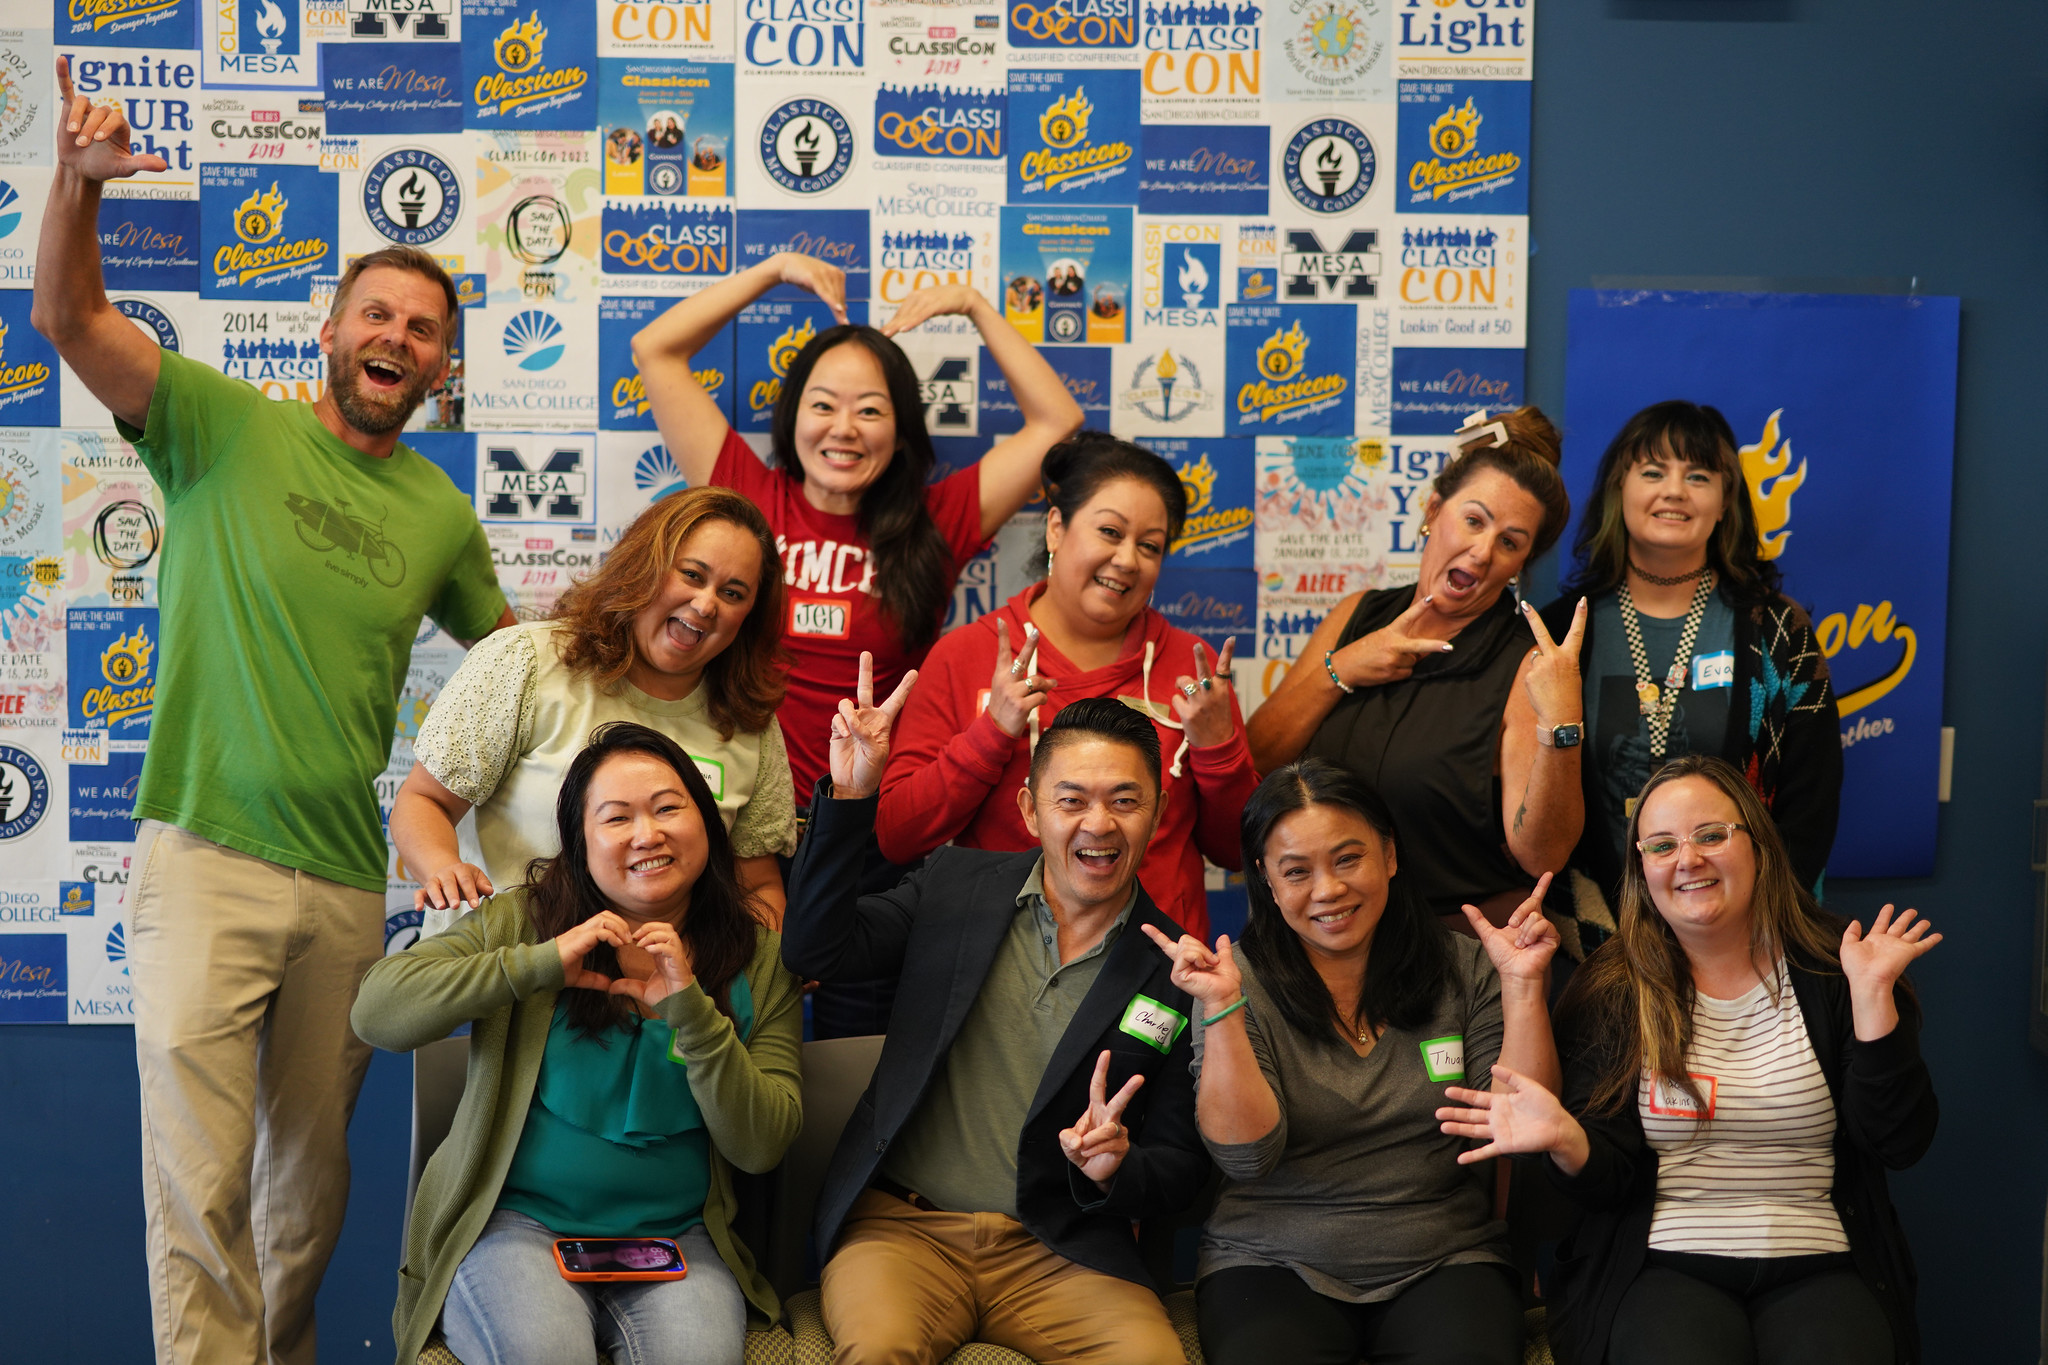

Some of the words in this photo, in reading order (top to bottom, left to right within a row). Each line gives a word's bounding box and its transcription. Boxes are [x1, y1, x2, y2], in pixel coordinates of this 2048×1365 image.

[306, 10, 346, 26] CON
[745, 0, 867, 22] CLASSI
[71, 21, 92, 33] 2026
[612, 3, 711, 42] CON
[1054, 17, 1133, 44] CON
[1145, 27, 1260, 50] CLASSI
[1399, 13, 1526, 54] Light
[745, 22, 864, 67] CON
[2, 48, 32, 79] 2021
[220, 56, 298, 73] MESA
[1144, 50, 1260, 95] CON
[333, 78, 353, 90] WE
[358, 78, 384, 90] ARE
[379, 65, 452, 98] Mesa
[475, 66, 587, 106] Classicon
[622, 75, 709, 88] Classicon
[762, 102, 852, 145] CLASSICON
[922, 107, 1001, 129] CLASSI
[249, 143, 285, 159] 2019
[921, 127, 1001, 156] CON
[1286, 122, 1374, 165] CLASSICON
[320, 153, 358, 168] CON
[1020, 141, 1132, 182] Classicon
[1145, 160, 1165, 171] WE
[1169, 160, 1195, 171] ARE
[367, 151, 458, 198] CLASSICON
[764, 157, 795, 189] Mesa
[800, 157, 848, 191] College
[1408, 151, 1520, 191] Classicon
[907, 183, 937, 197] SAN
[938, 184, 977, 198] DIEGO
[1288, 178, 1318, 210] Mesa
[1323, 177, 1371, 212] College
[530, 212, 555, 222] SAVE
[875, 197, 926, 217] MESA
[923, 197, 997, 219] COLLEGE
[369, 206, 399, 241] Mesa
[405, 205, 453, 243] College
[1023, 224, 1110, 236] Classicon
[1166, 225, 1220, 241] CON
[119, 222, 188, 256] Mesa
[526, 237, 553, 248] DATE
[648, 224, 727, 246] CLASSI
[214, 237, 328, 276] Classicon
[1238, 239, 1277, 255] CON
[648, 244, 727, 272] CON
[881, 250, 972, 270] CLASSI
[1144, 224, 1161, 308] CLASSI
[1300, 255, 1364, 273] MESA
[1401, 248, 1496, 268] CLASSI
[217, 275, 238, 288] 2026
[524, 283, 556, 296] CON
[1399, 267, 1496, 304] CON
[223, 312, 268, 333] 2014
[303, 311, 320, 322] Good
[1144, 311, 1217, 327] MESA
[1445, 317, 1474, 334] Good
[1479, 319, 1490, 333] at
[1494, 319, 1511, 333] 50
[223, 360, 323, 380] CLASSI
[502, 379, 525, 389] SAN
[527, 380, 566, 390] DIEGO
[1238, 373, 1347, 413] Classicon
[1400, 380, 1419, 392] WE
[1423, 380, 1449, 392] ARE
[471, 393, 517, 409] MESA
[523, 393, 598, 411] COLLEGE
[8, 448, 40, 479] 2021
[501, 474, 568, 492] MESA
[16, 502, 45, 540] Mosaic
[117, 517, 142, 528] SAVE
[119, 530, 138, 540] THE
[113, 542, 142, 552] DATE
[112, 588, 144, 601] CON
[797, 603, 845, 632] Jen
[12, 654, 42, 666] DATE
[61, 746, 100, 761] CON
[78, 787, 98, 798] WE
[103, 787, 128, 798] ARE
[110, 808, 132, 819] Colleg
[106, 985, 130, 995] SAN
[74, 999, 123, 1016] MESA
[1134, 1010, 1170, 1036] Charlie
